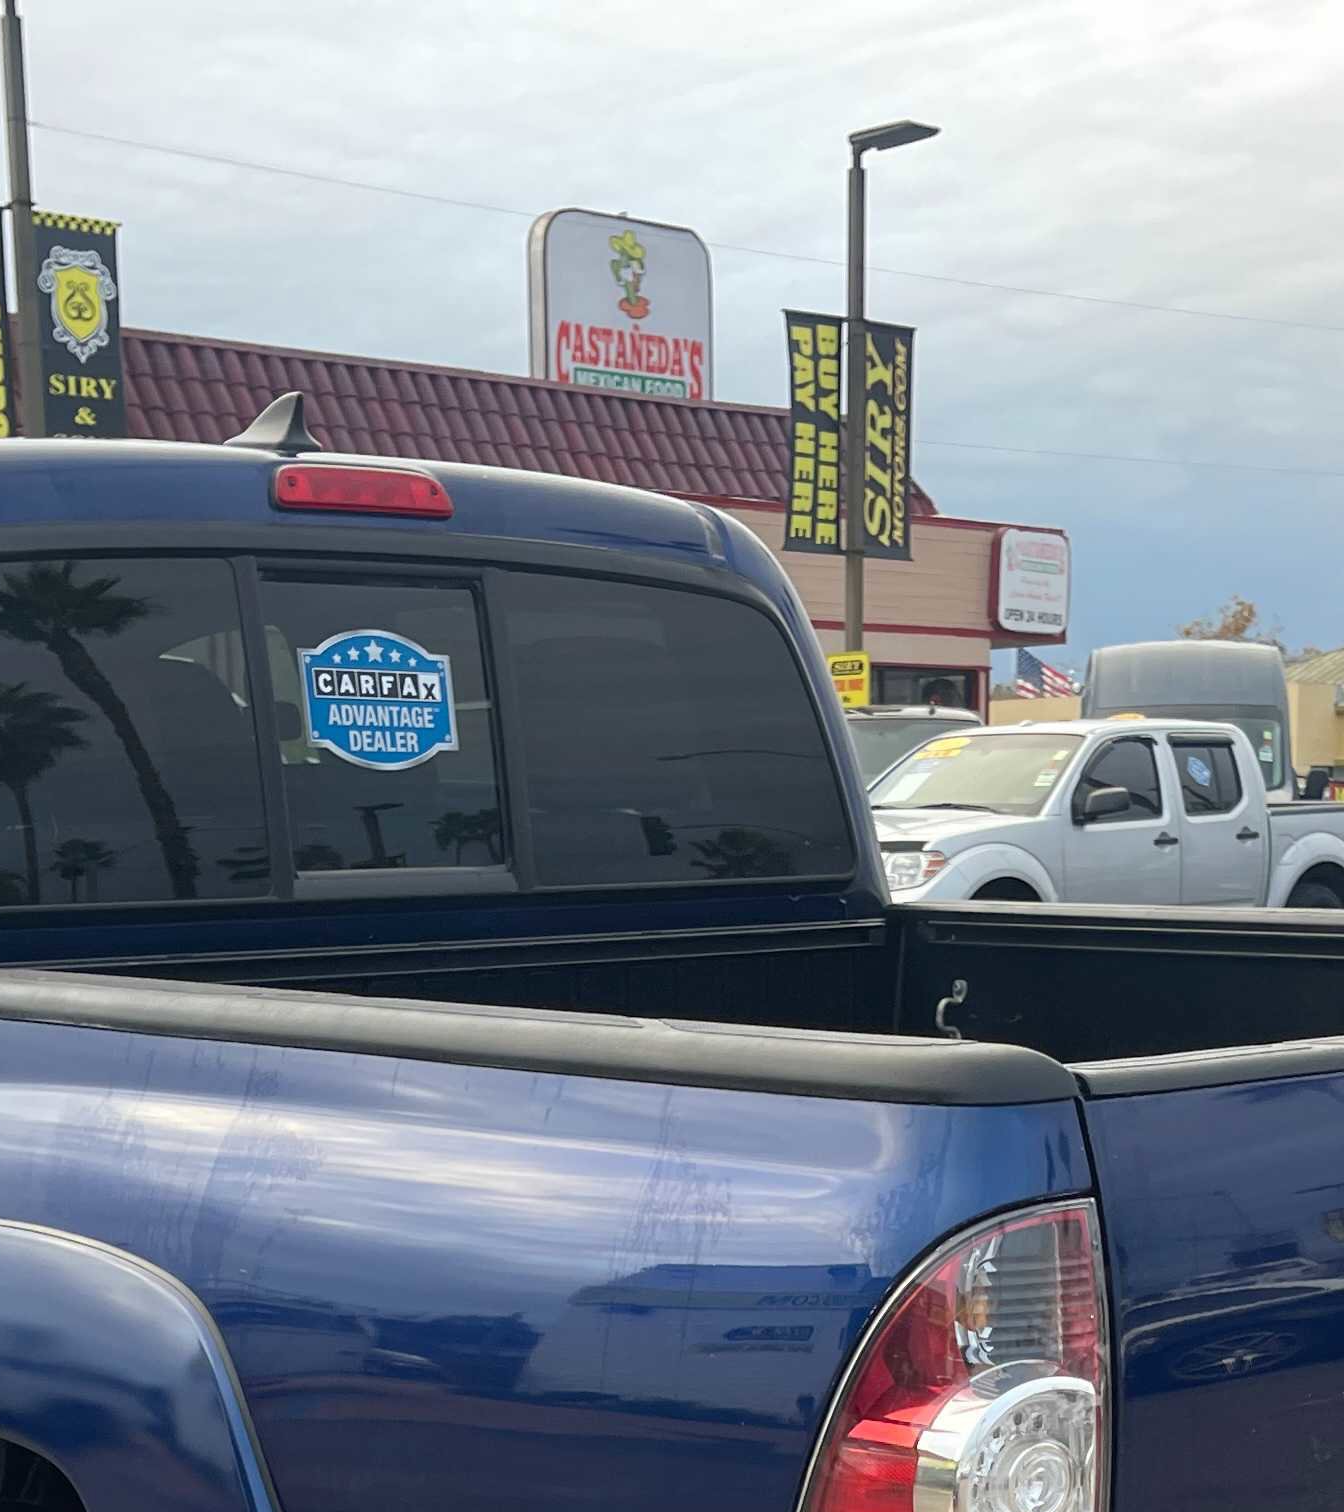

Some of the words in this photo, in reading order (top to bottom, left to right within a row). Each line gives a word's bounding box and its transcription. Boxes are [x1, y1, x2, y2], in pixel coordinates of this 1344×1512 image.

[49, 374, 117, 399] SIRY
[790, 325, 816, 412] PAY
[816, 324, 838, 420] BUY
[74, 406, 97, 426] &
[864, 331, 893, 547] SIRY
[790, 422, 816, 538] HERE
[815, 431, 838, 544] HERE
[317, 672, 438, 700] CARFAX
[329, 704, 434, 728] ADVANTAGE
[349, 731, 419, 752] DEALER
